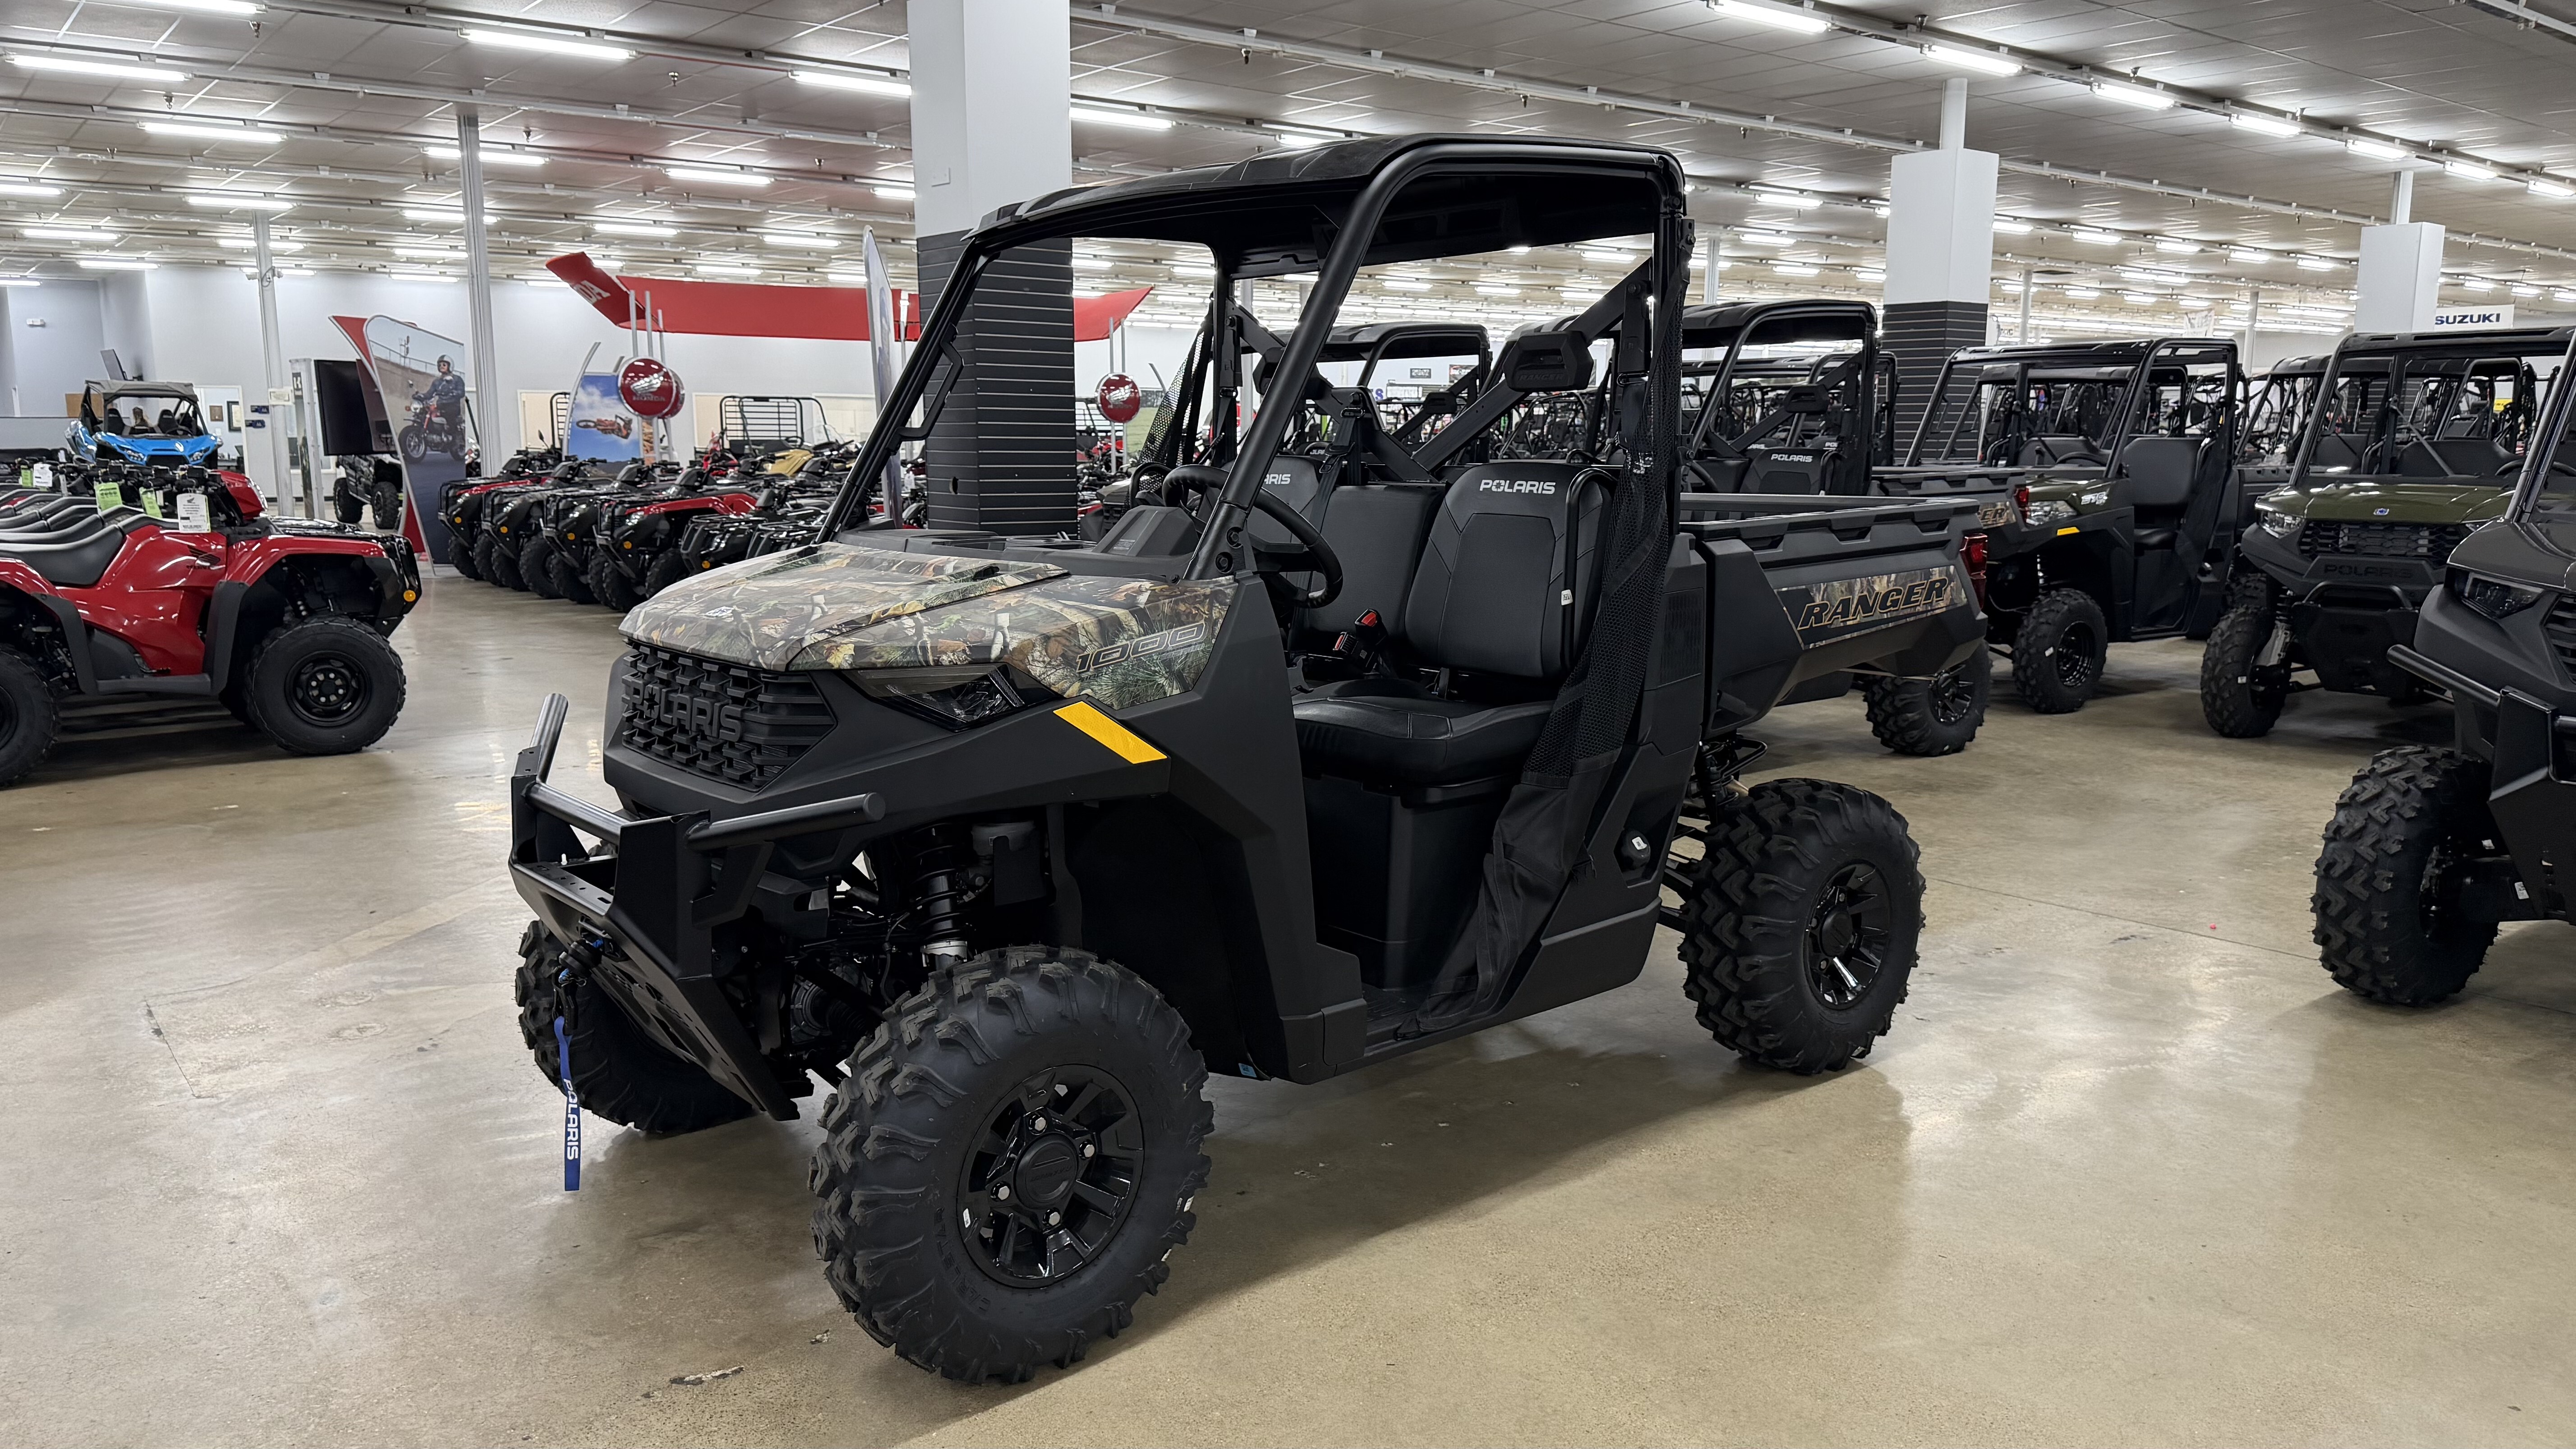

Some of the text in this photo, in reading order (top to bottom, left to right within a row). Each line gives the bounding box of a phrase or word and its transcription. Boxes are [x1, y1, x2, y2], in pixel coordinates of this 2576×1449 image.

[2435, 313, 2501, 325] SUZUKI
[1771, 454, 1813, 462] POLARIS
[1479, 479, 1556, 494] POLARIS
[2324, 564, 2413, 579] POLARIS
[1797, 577, 1948, 630] RANGER
[1076, 621, 1206, 674] 1000
[630, 678, 743, 742] POLARIS
[563, 1078, 579, 1160] POLARIS
